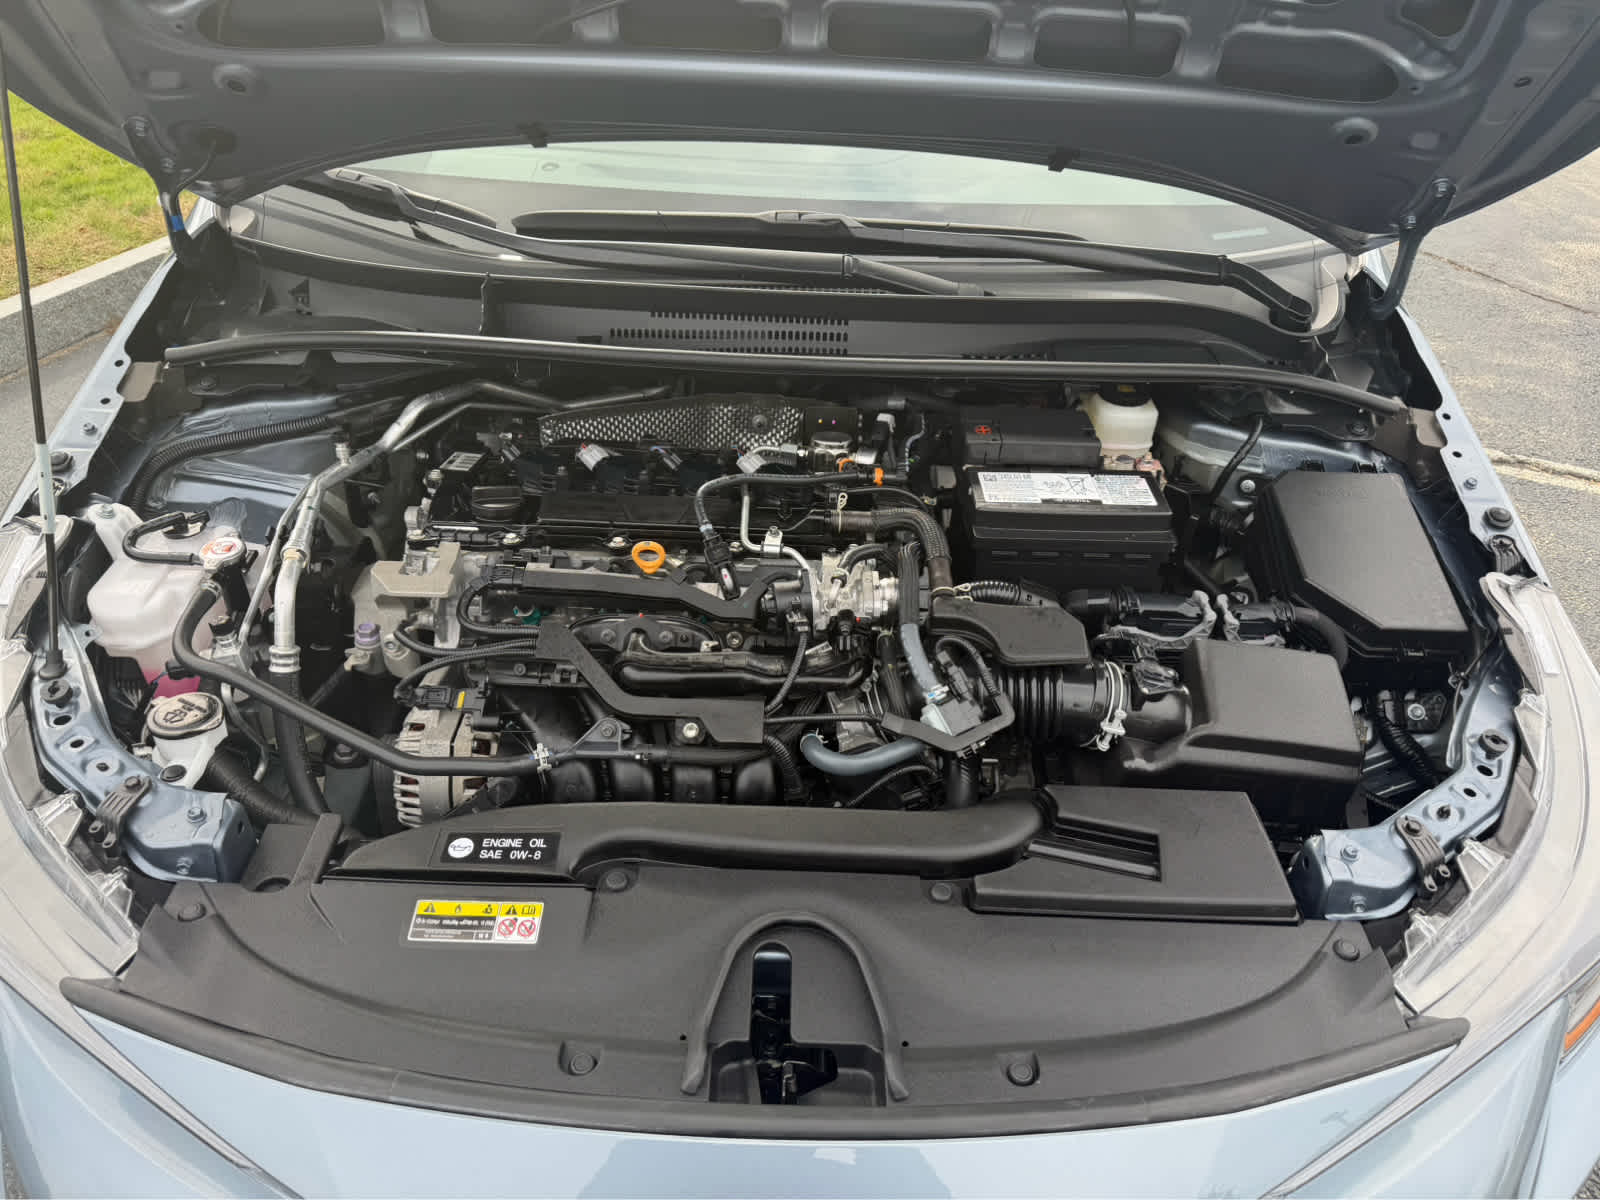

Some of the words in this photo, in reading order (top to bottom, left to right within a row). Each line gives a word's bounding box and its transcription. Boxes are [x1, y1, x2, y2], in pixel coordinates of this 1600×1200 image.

[482, 838, 523, 848] ENGINE
[529, 838, 547, 848] OIL
[479, 849, 503, 859] SAE
[509, 850, 541, 860] 0W-8
